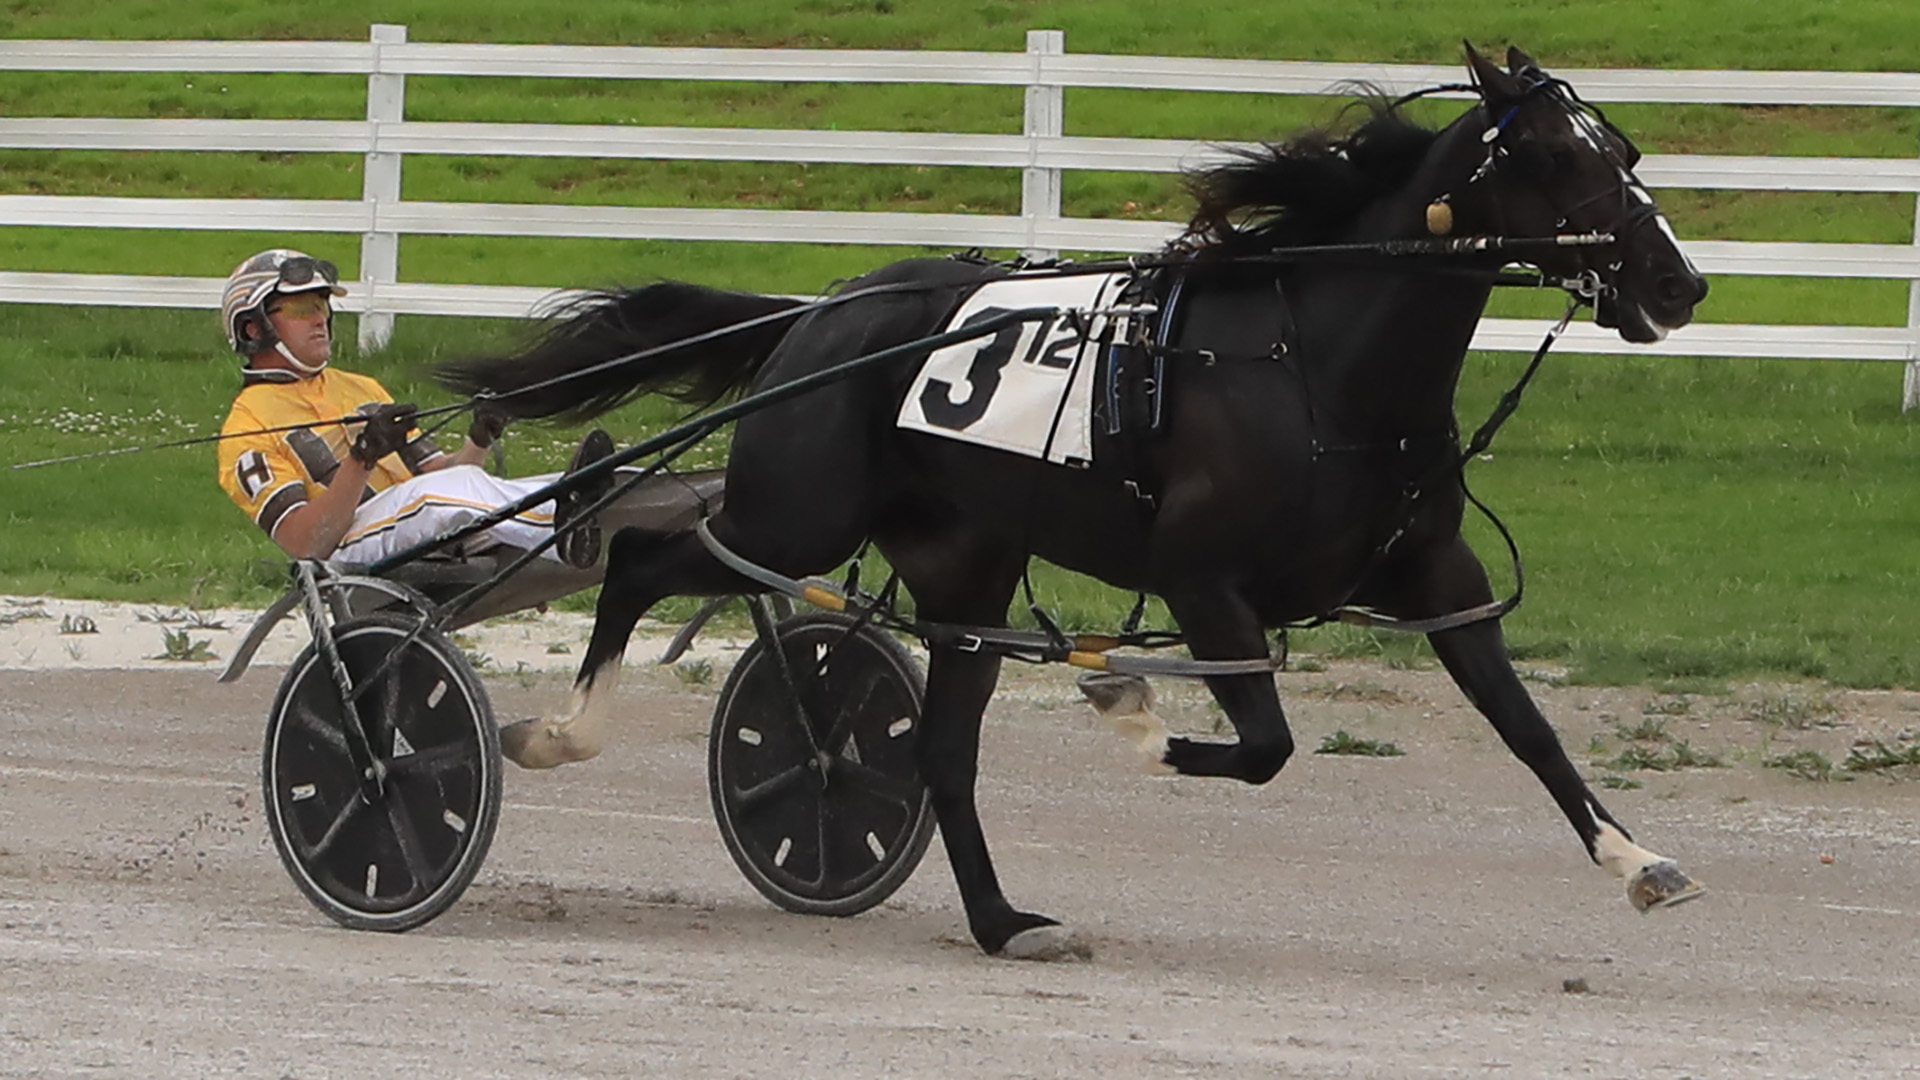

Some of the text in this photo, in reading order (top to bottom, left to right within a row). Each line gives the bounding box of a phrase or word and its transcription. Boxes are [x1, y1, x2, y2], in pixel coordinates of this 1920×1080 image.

[919, 306, 1083, 431] 3 12
[236, 450, 273, 502] H
